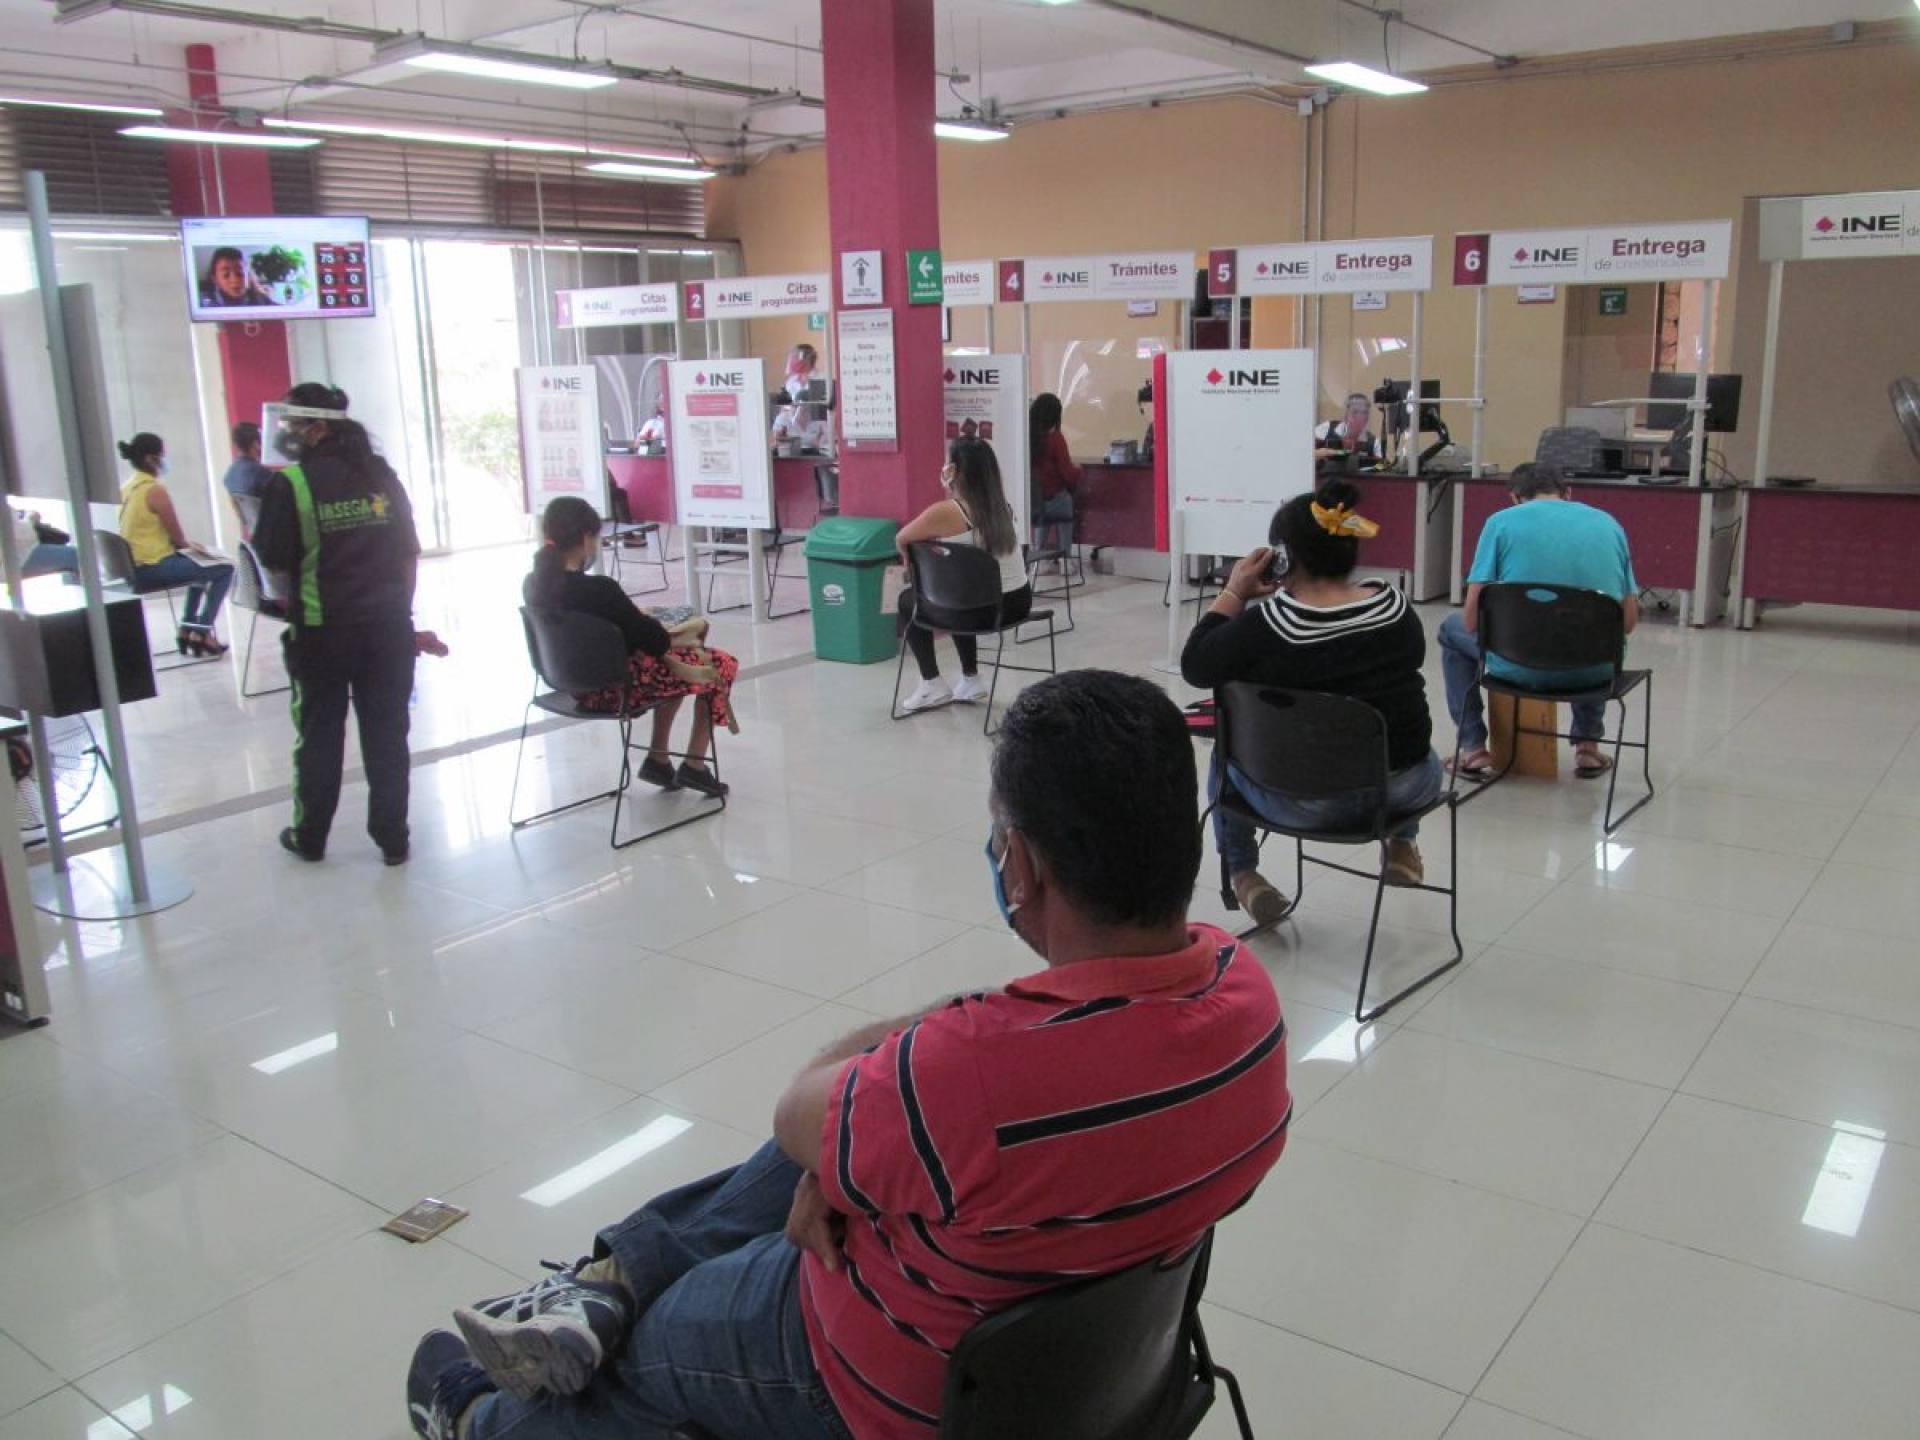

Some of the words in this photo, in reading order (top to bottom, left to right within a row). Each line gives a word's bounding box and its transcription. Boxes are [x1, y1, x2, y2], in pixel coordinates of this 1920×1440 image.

[1841, 214, 1901, 233] INE
[1533, 247, 1578, 262] INE
[1612, 238, 1705, 258] Entrega
[1272, 261, 1309, 275] INE
[1335, 253, 1412, 272] Entrega
[1464, 250, 1481, 271] 6
[1594, 258, 1612, 270] de
[1109, 261, 1178, 277] Trámites
[1217, 263, 1230, 282] 5
[943, 271, 980, 284] mites
[1006, 272, 1020, 290] 4
[1056, 271, 1089, 283] INE
[1322, 271, 1337, 283] de
[786, 282, 818, 295] Citas
[641, 293, 667, 304] Citas
[691, 293, 702, 308] 2
[728, 291, 753, 303] INE
[760, 295, 819, 308] programadas
[553, 377, 583, 390] INE
[709, 372, 743, 387] INE
[960, 369, 999, 385] INE
[1229, 369, 1280, 386] INE
